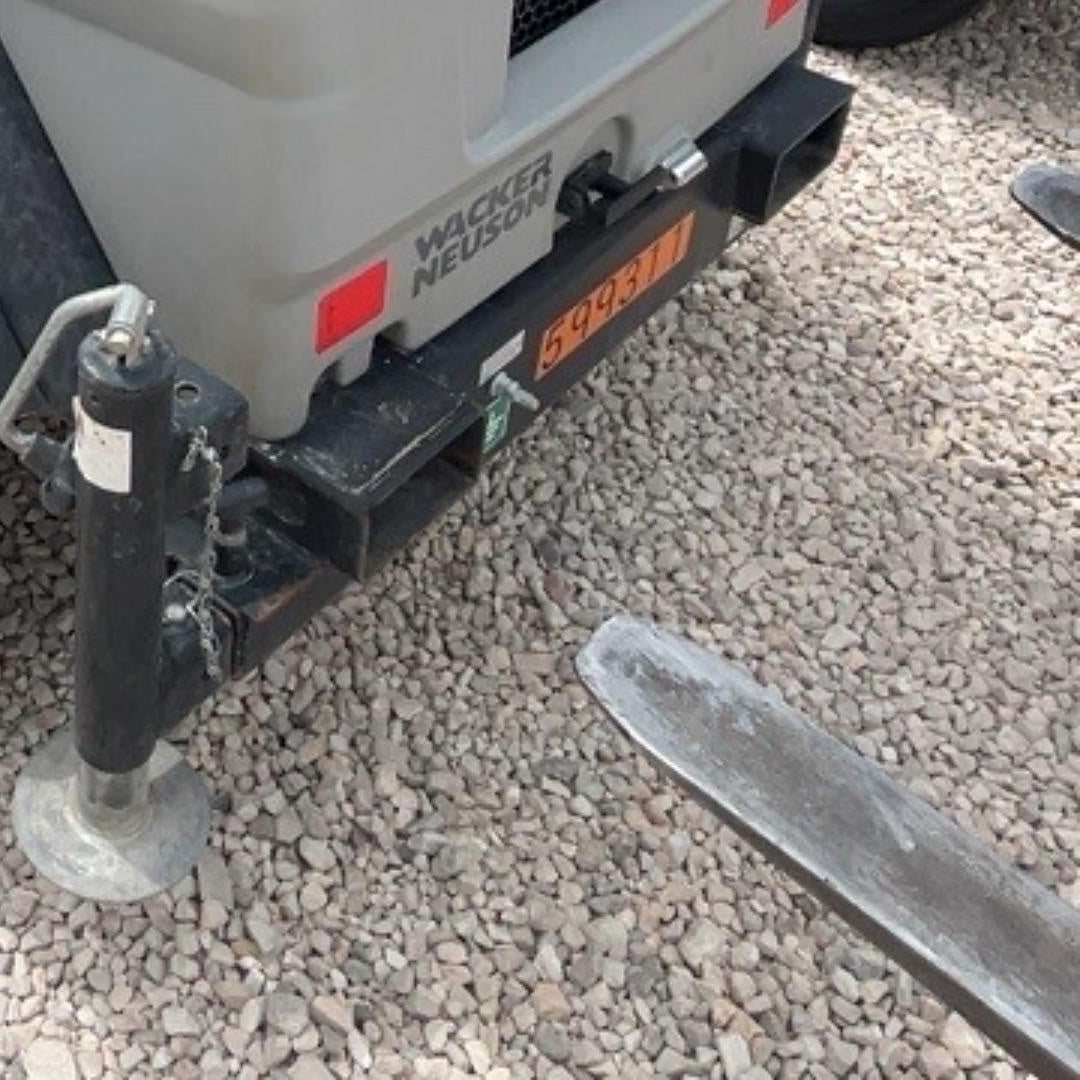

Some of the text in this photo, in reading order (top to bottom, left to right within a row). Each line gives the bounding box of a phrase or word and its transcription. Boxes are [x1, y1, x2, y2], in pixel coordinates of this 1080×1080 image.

[411, 178, 551, 299] NEUSON
[414, 149, 553, 262] WACKER
[542, 220, 685, 370] 599311
